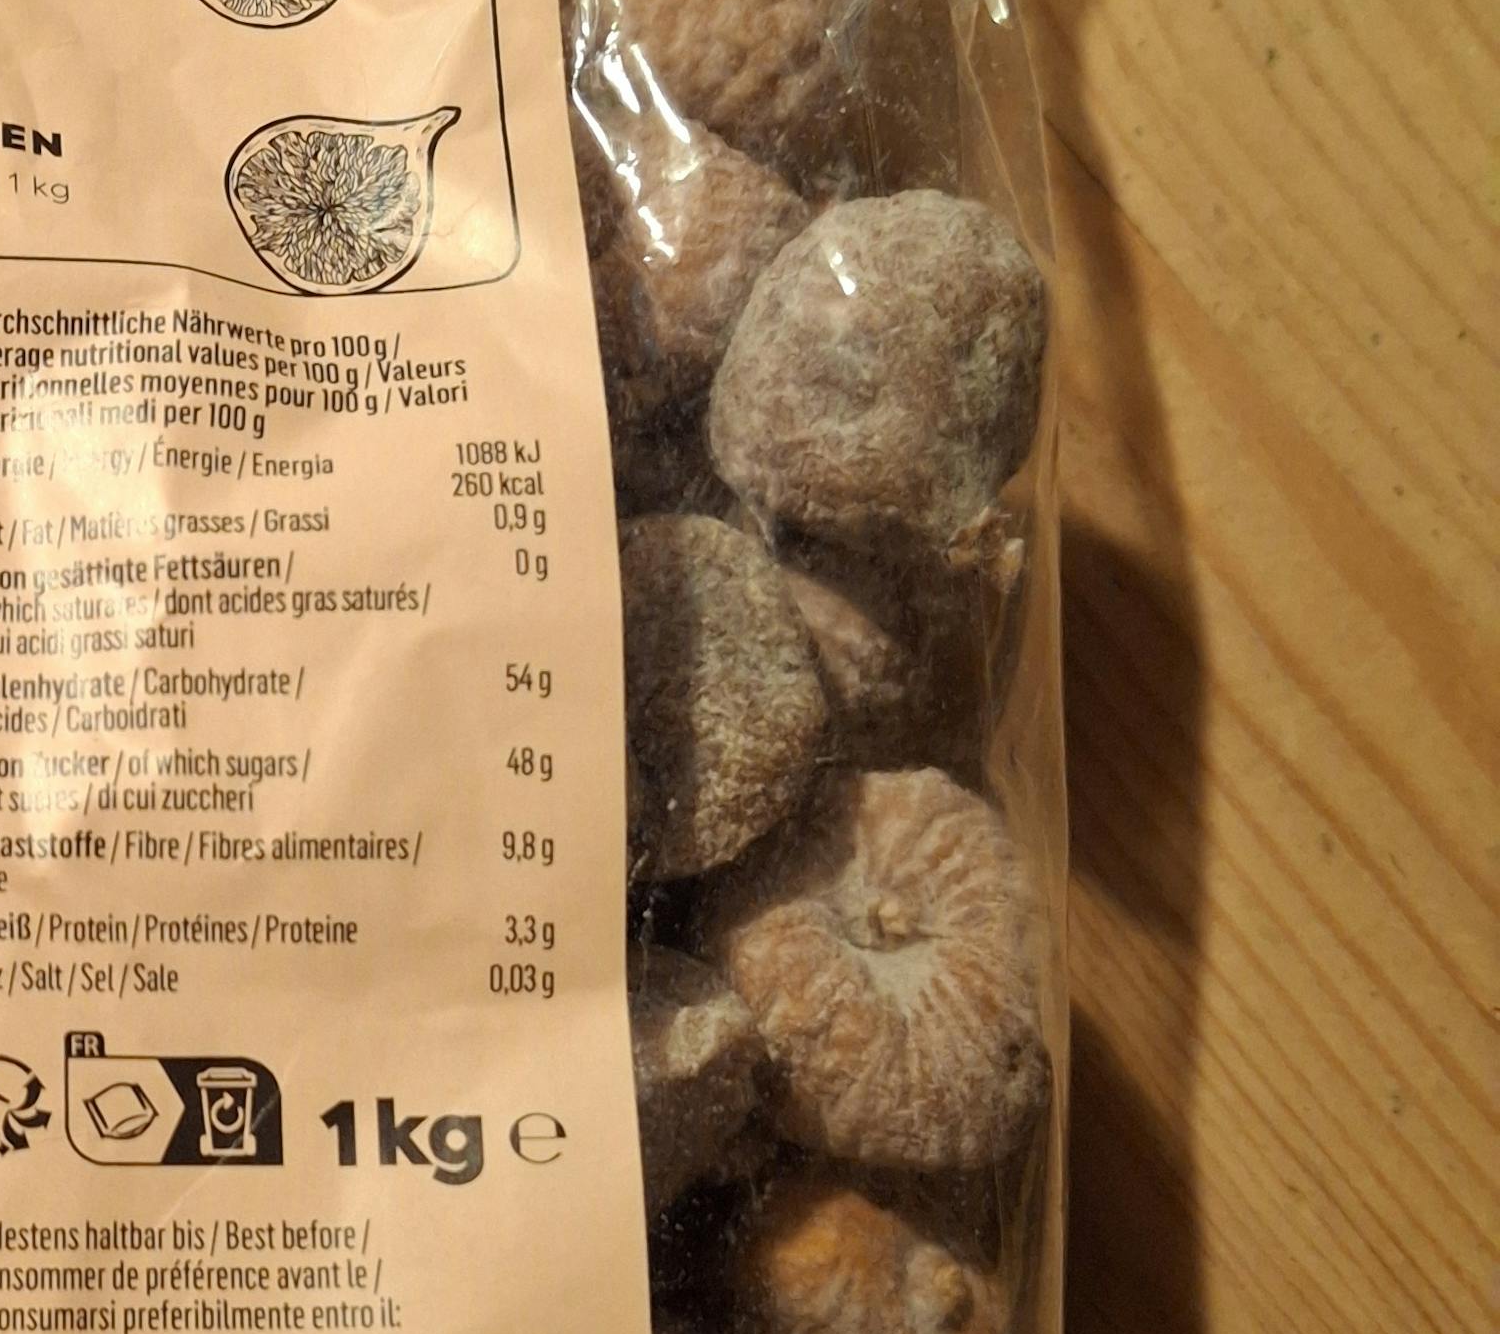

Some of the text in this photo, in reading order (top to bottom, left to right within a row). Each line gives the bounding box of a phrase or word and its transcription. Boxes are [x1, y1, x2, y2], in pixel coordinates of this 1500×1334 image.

[8, 171, 19, 194] 1
[172, 308, 285, 351] Nährwerte
[289, 338, 326, 359] pro
[60, 338, 183, 368] nutritional
[187, 341, 259, 371] values
[264, 356, 298, 378] per
[302, 360, 340, 385] 100
[345, 367, 359, 393] g
[375, 353, 466, 385] Valeurs
[137, 374, 468, 416] moyennes pour 100 g Valori
[455, 439, 541, 466] 1088 kJ
[450, 470, 545, 498] 260 kcal
[263, 506, 330, 533] Grassi
[493, 502, 547, 536] 0,9 g
[515, 547, 549, 582] 0 g
[164, 581, 420, 620] dont acides gras saturés
[143, 666, 291, 702] Carbohydrate
[505, 662, 552, 699] 54 g
[225, 754, 299, 786] sugars
[506, 746, 553, 783] 48 g
[125, 829, 180, 860] Fibre
[199, 830, 266, 862] Fibres
[271, 830, 410, 862] alimentaires
[502, 830, 555, 867] 9,8 g
[49, 913, 128, 944] Protein
[144, 913, 249, 944] Protéines
[265, 914, 358, 945] Proteine
[504, 914, 555, 951] 3,3 g
[20, 960, 63, 992] Salt
[80, 961, 115, 993] Sel
[133, 962, 179, 993] Sale
[489, 963, 555, 1000] 0,03 g
[70, 1034, 99, 1056] FR
[85, 1220, 166, 1251] haltbar
[172, 1219, 205, 1251] bis
[225, 1220, 276, 1251] Best
[281, 1219, 356, 1251] before
[112, 1259, 139, 1291] de
[145, 1258, 270, 1297] préférence
[276, 1261, 341, 1291] avant
[346, 1258, 368, 1290] le
[311, 1301, 375, 1331] entro
[379, 1296, 402, 1329] il:
